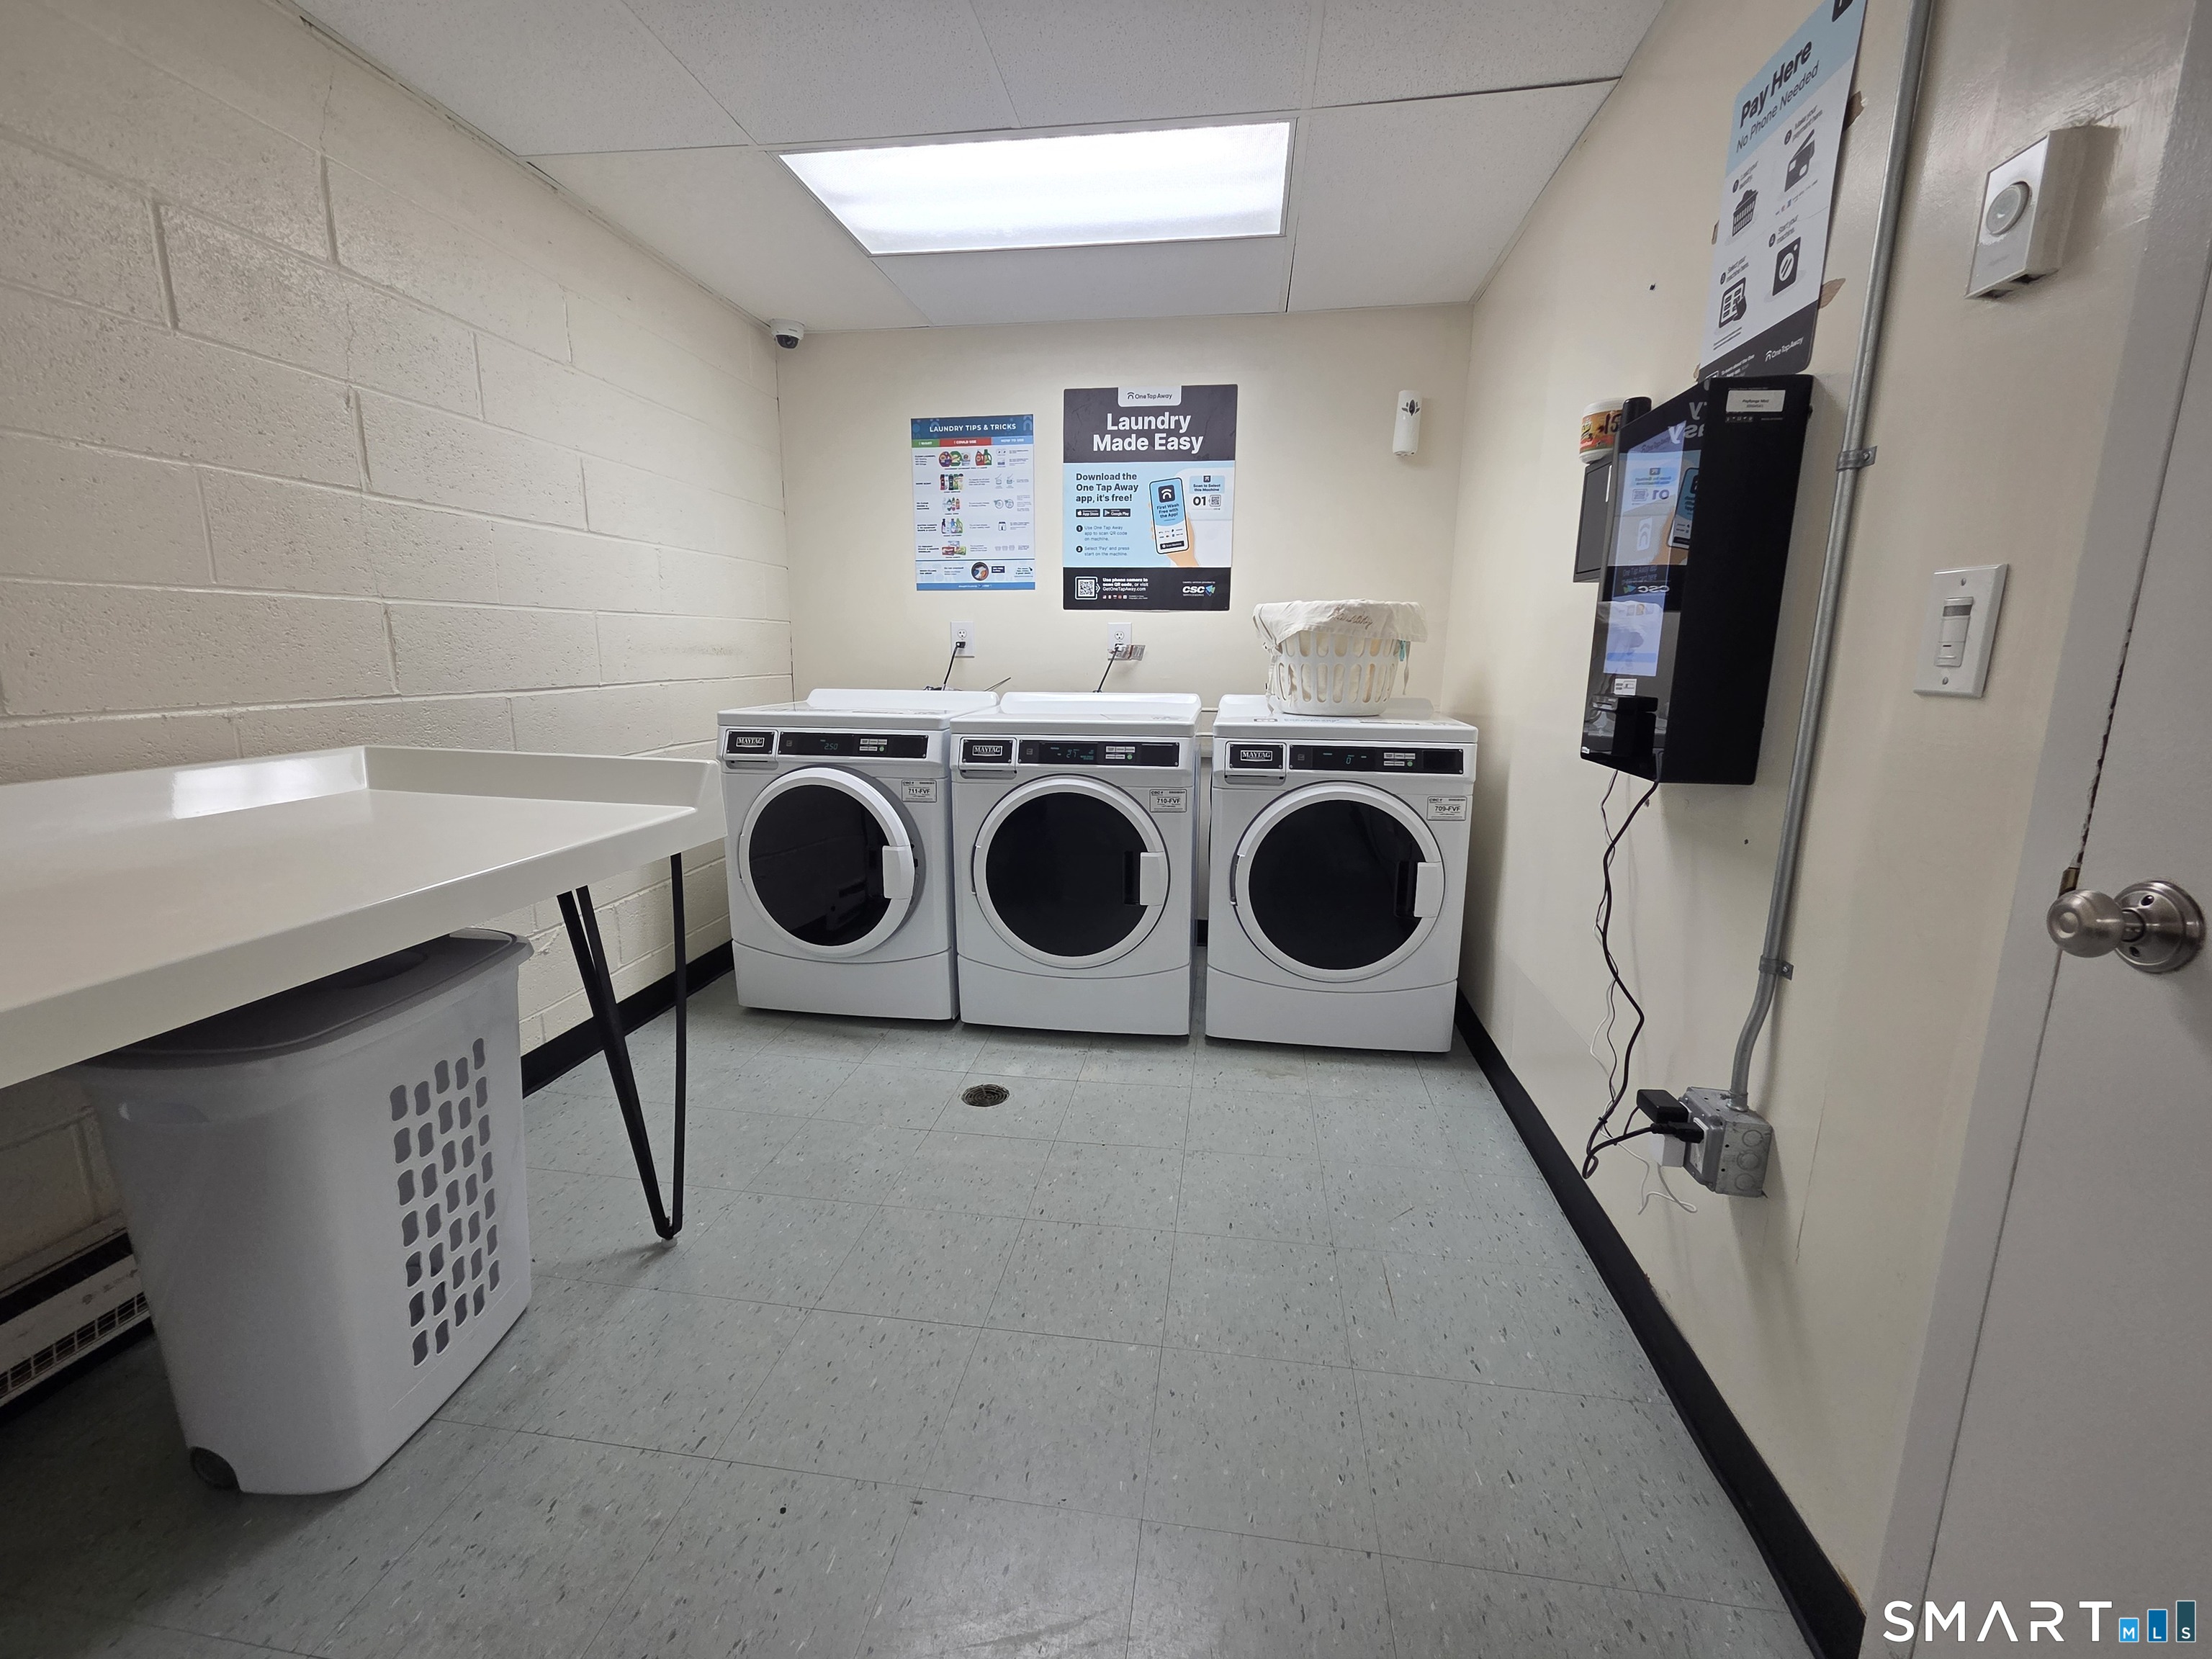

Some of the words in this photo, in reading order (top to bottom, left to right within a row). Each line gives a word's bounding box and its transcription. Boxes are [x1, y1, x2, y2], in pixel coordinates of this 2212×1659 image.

[1740, 84, 1770, 129] Pay
[1771, 41, 1812, 97] Here
[1736, 135, 1748, 153] No
[1750, 105, 1778, 140] Phone
[1779, 60, 1820, 110] Needed
[1107, 412, 1191, 433] Laundry
[1093, 433, 1148, 451] Made
[1154, 433, 1204, 454] Easy
[1096, 484, 1112, 493] Tap
[1114, 483, 1138, 493] Away
[1193, 496, 1206, 505] 01
